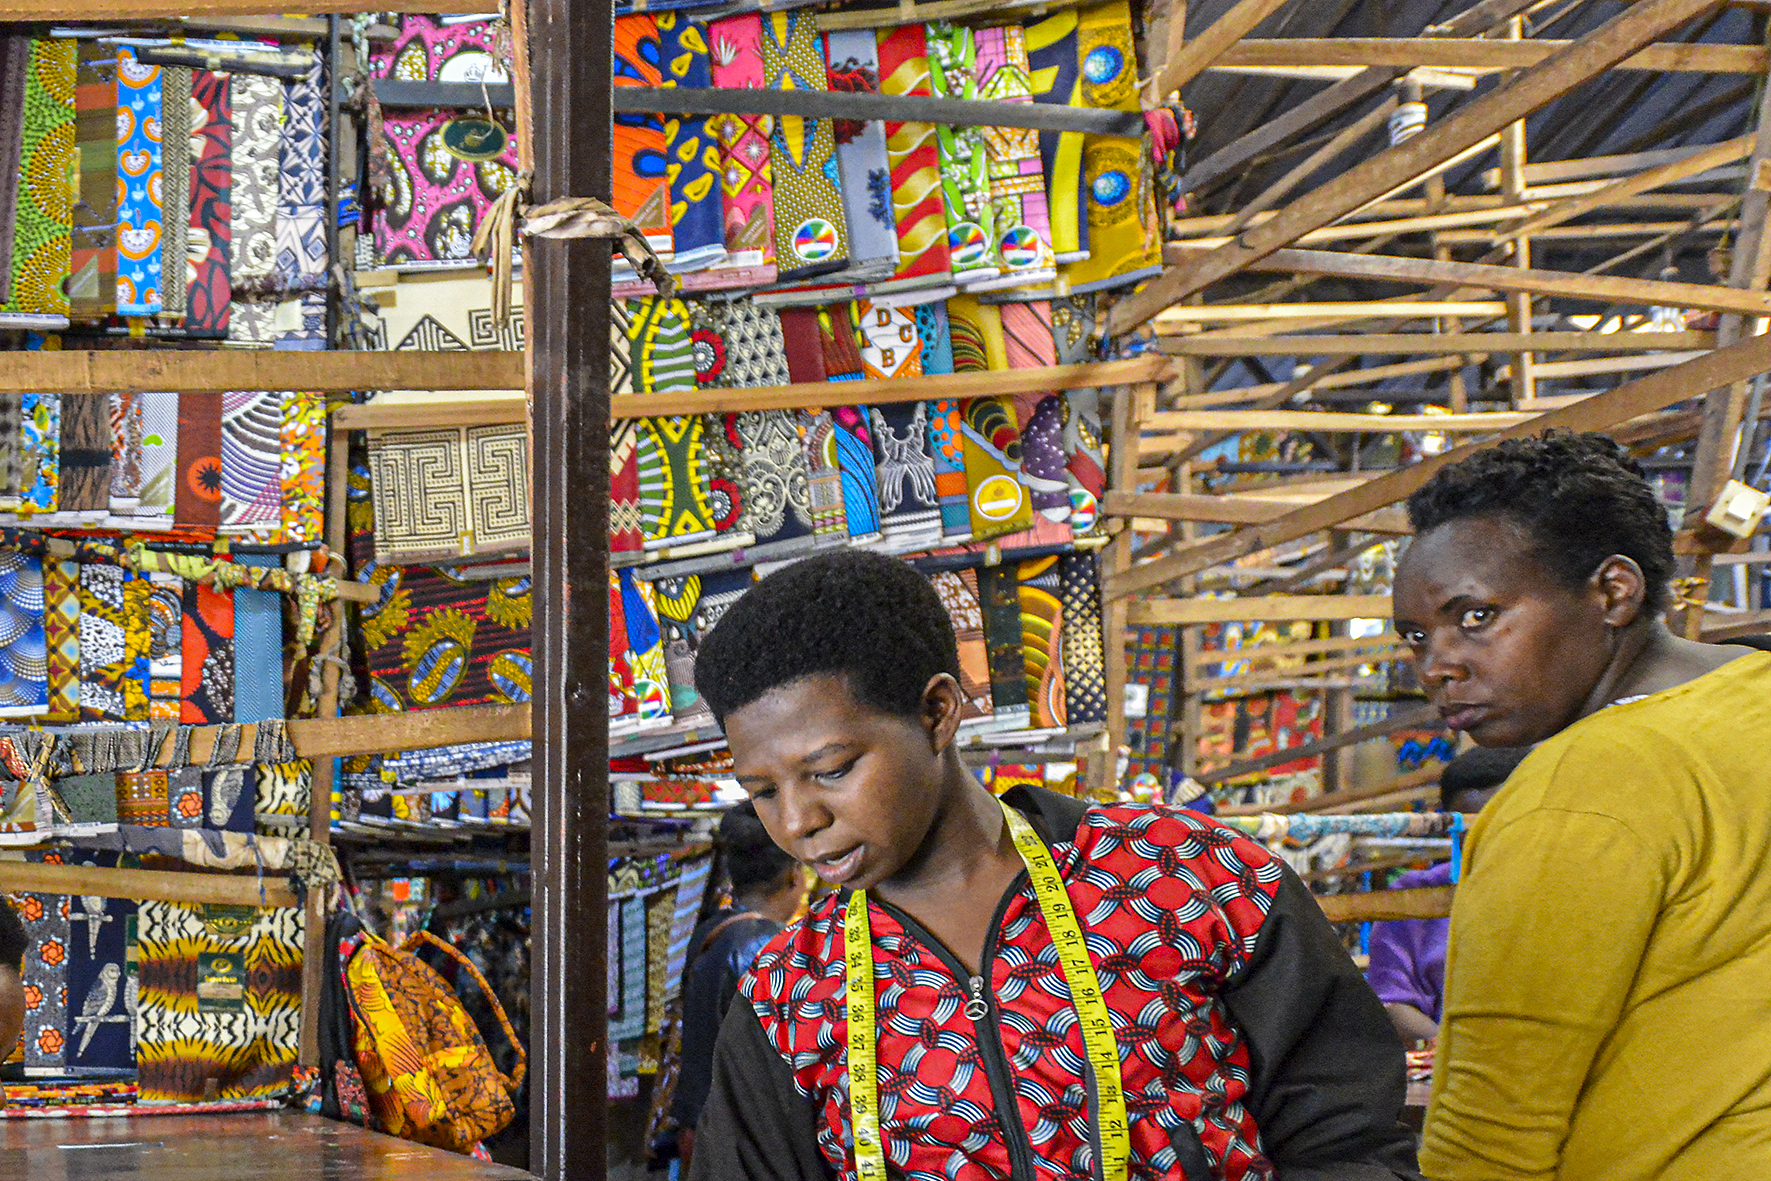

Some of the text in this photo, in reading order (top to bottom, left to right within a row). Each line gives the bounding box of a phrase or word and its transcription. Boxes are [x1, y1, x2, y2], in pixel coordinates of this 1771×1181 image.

[1032, 853, 1049, 869] 21
[1042, 875, 1060, 892] 20
[1052, 902, 1069, 919] 19
[1066, 928, 1080, 947] 18
[850, 951, 863, 969] 34
[1076, 957, 1089, 975] 17
[1082, 986, 1096, 1005] 16
[851, 1004, 865, 1023] 36
[1091, 1017, 1108, 1036] 15
[851, 1033, 866, 1052] 37
[1101, 1051, 1115, 1070] 14
[852, 1063, 866, 1083] 38
[853, 1094, 868, 1115] 39
[857, 1126, 872, 1147] 40
[1110, 1118, 1124, 1138] 12
[860, 1159, 876, 1179] 41
[1113, 1157, 1125, 1173] 11
